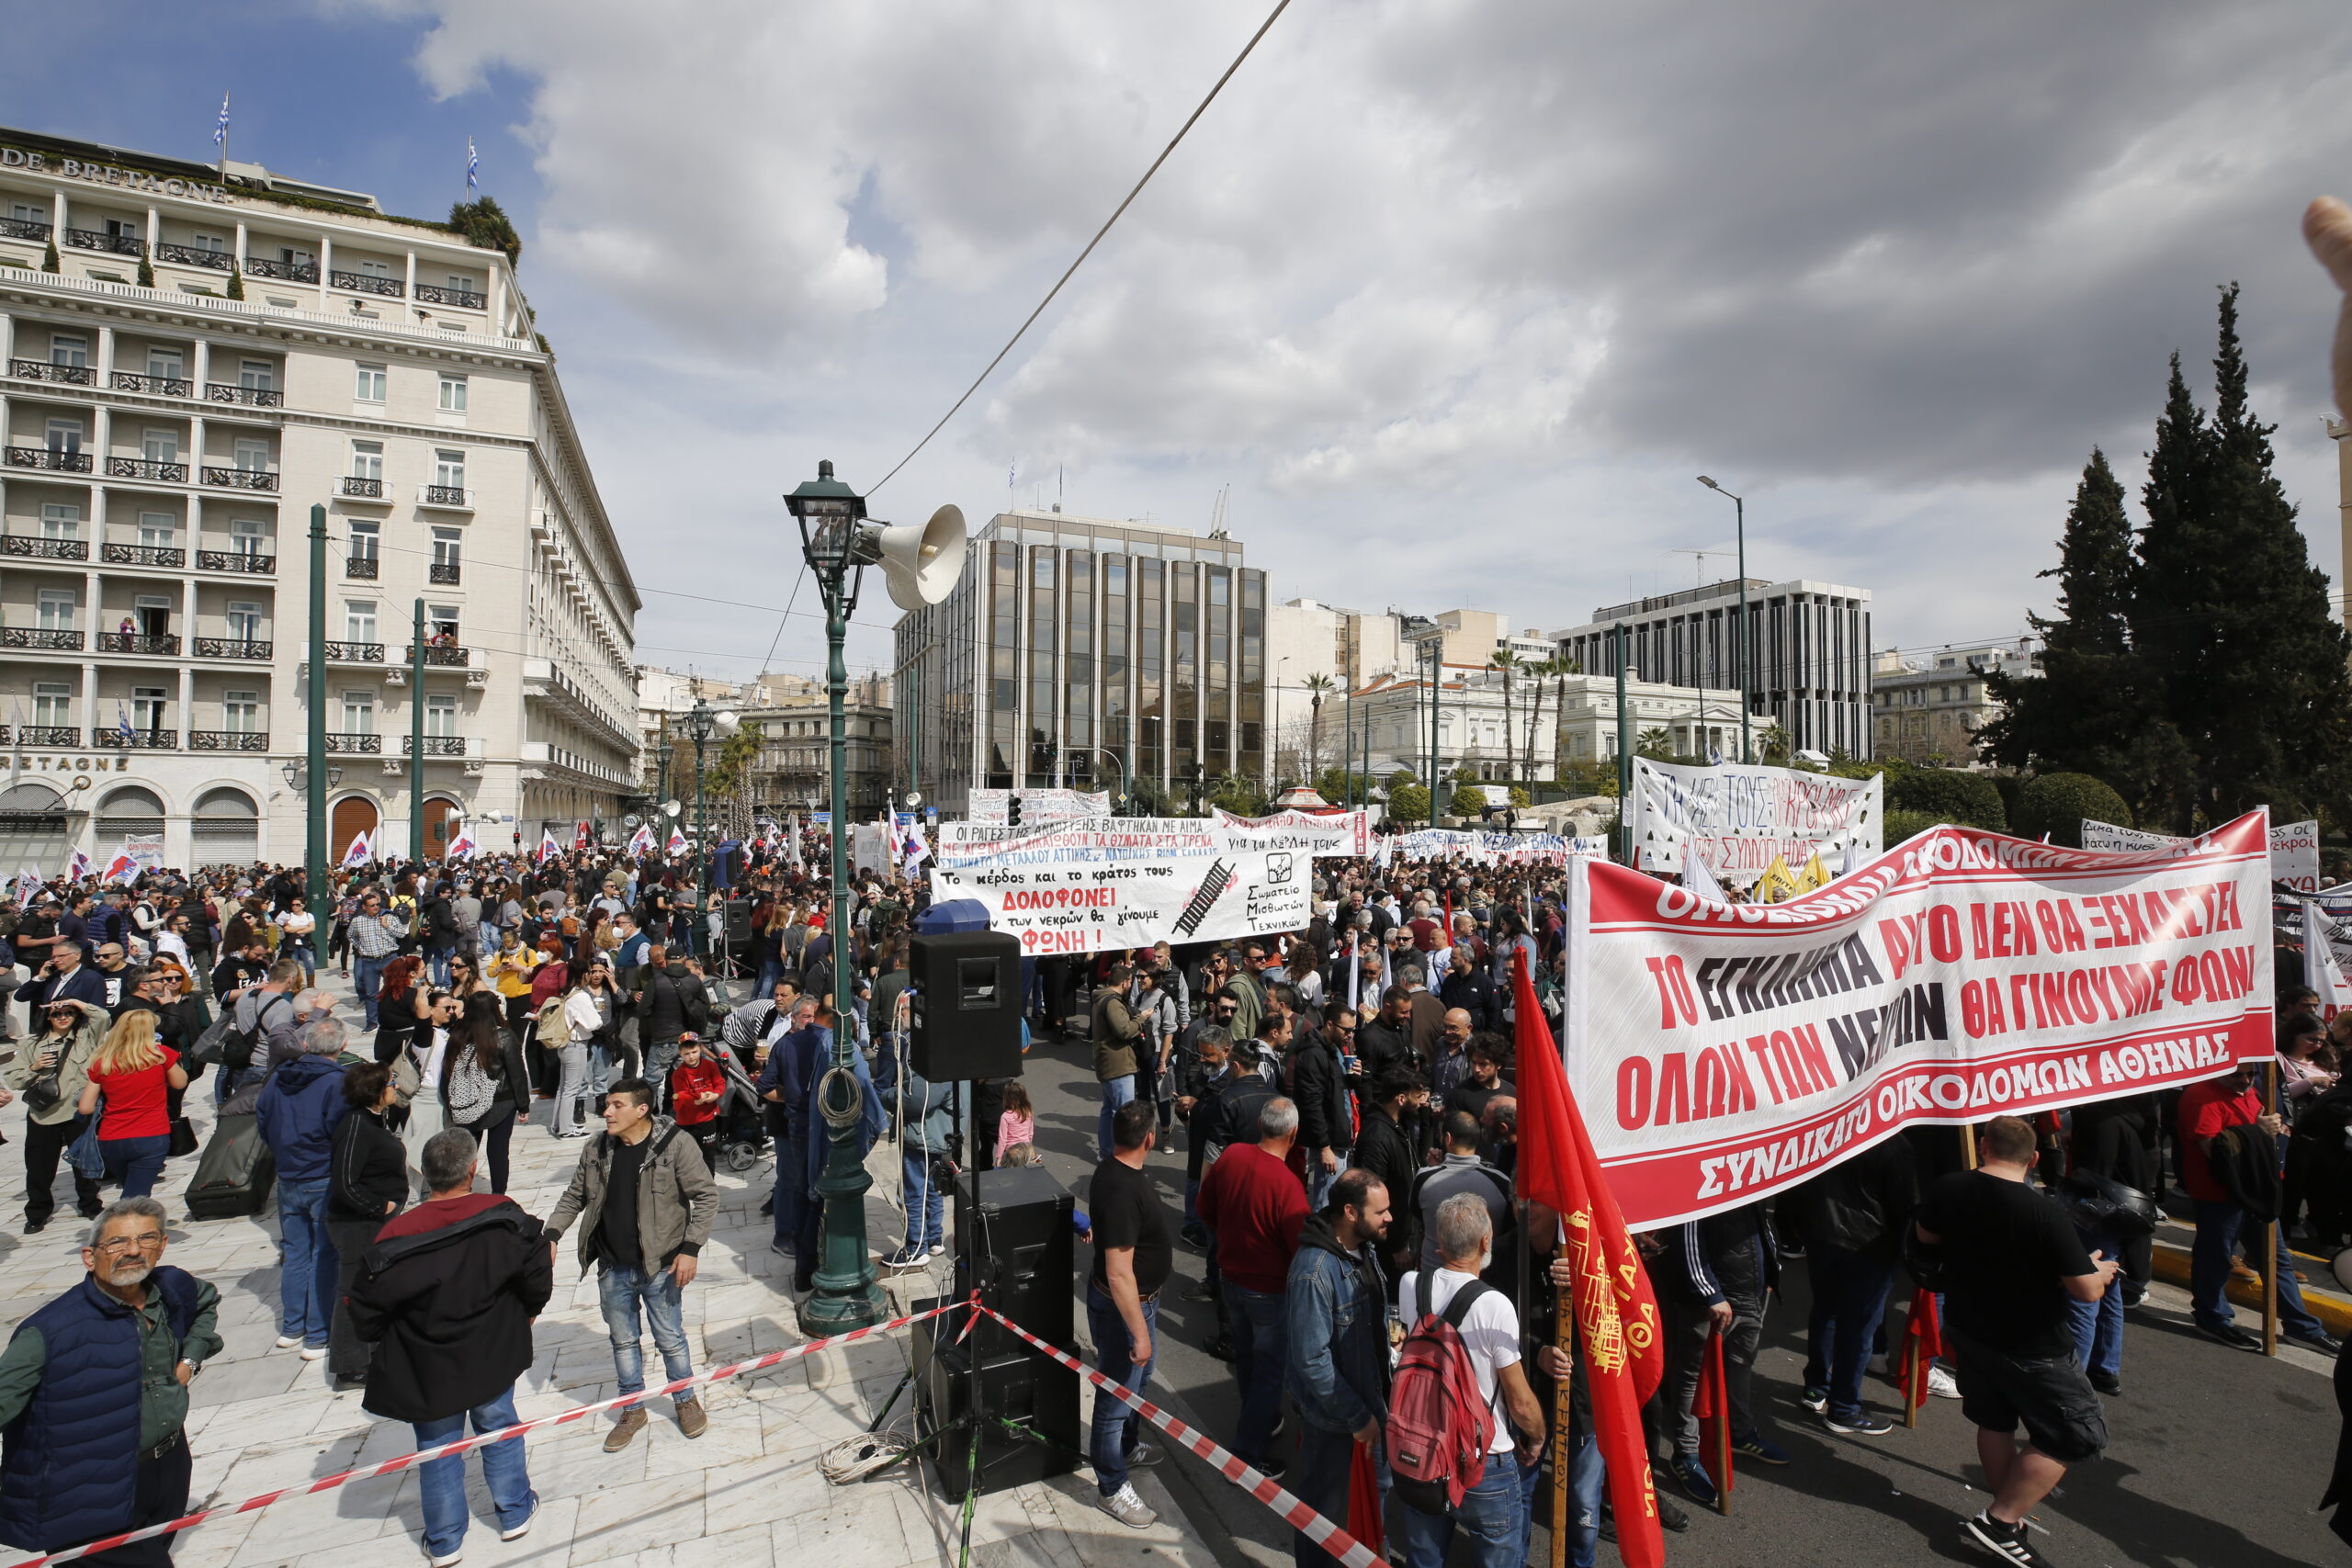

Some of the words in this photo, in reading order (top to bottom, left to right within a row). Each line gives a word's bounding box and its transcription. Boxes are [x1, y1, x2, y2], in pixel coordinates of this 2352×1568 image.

[1, 147, 45, 172] DE
[62, 158, 229, 204] BRETAGNE
[1724, 775, 1767, 828] ΤΟΥΣ
[956, 829, 967, 841] ΟΙ
[971, 829, 1004, 841] ΡΑΓΕΣ
[1007, 828, 1030, 839] ΤΗΣ
[1102, 819, 1158, 833] ΒΑΦΤΗΚΑΝ
[1162, 820, 1176, 833] ΜΕ
[1180, 819, 1203, 833] ΑΙΜΑ
[942, 843, 958, 856] ΜΕ
[965, 842, 1002, 855] ΑΓΩΝΑ
[1007, 840, 1021, 852] ΘΑ
[1094, 833, 1106, 846] ΤΑ
[1110, 834, 1153, 847] ΘΥΜΑΤΑ
[1157, 834, 1180, 847] ΣΤΑ
[1182, 834, 1213, 847] ΤΡΕΝΑ
[997, 850, 1049, 866] ΜΕΤΑΛΛΟΥ
[1054, 848, 1093, 863] ΑΤΤΙΚΗΣ
[940, 872, 960, 886] Το
[977, 868, 1025, 887] κέρδος
[1035, 872, 1057, 883] και
[1068, 871, 1082, 881] το
[1092, 864, 1136, 886] κράτος
[1145, 866, 1173, 877] τους
[1002, 887, 1116, 911] ΔΟΛΟΦΟΝΕΙ
[1248, 885, 1300, 900] Σωματείο
[1010, 919, 1033, 928] των
[1039, 911, 1083, 930] νεκρών
[1091, 909, 1105, 922] θα
[1117, 906, 1159, 927] γίνουμε
[1247, 900, 1304, 917] Μισθωτών
[1247, 917, 1301, 931] Τεχνικών
[1021, 929, 1085, 953] ΦΩΝΗ
[1645, 954, 1699, 1030] ΤΟ
[1696, 930, 1883, 1021] ΕΓΚΛΗΜΑ
[1878, 904, 1962, 980] ΑΥΤΟ
[1972, 896, 2037, 961] ΔΕΝ
[2037, 898, 2084, 955] ΘΑ
[2081, 880, 2243, 949] ΞΕΧΑΣΤΕΙ
[1616, 1041, 1757, 1130] ΟΛΩΝ
[1746, 1022, 1838, 1105] ΤΩΝ
[1826, 982, 1948, 1081] ΝΕΚΡΩΝ
[1960, 976, 2007, 1039] ΘΑ
[2010, 959, 2167, 1031] ΓΙΝΟΥΜΕ
[1697, 1098, 1871, 1200] ΣΥΝΔΙΚΑΤΟ
[1877, 1055, 2092, 1115] ΟΙΚΟΔΟΜΩΝ
[2100, 1032, 2230, 1086] ΑΘΗΝΑΣ
